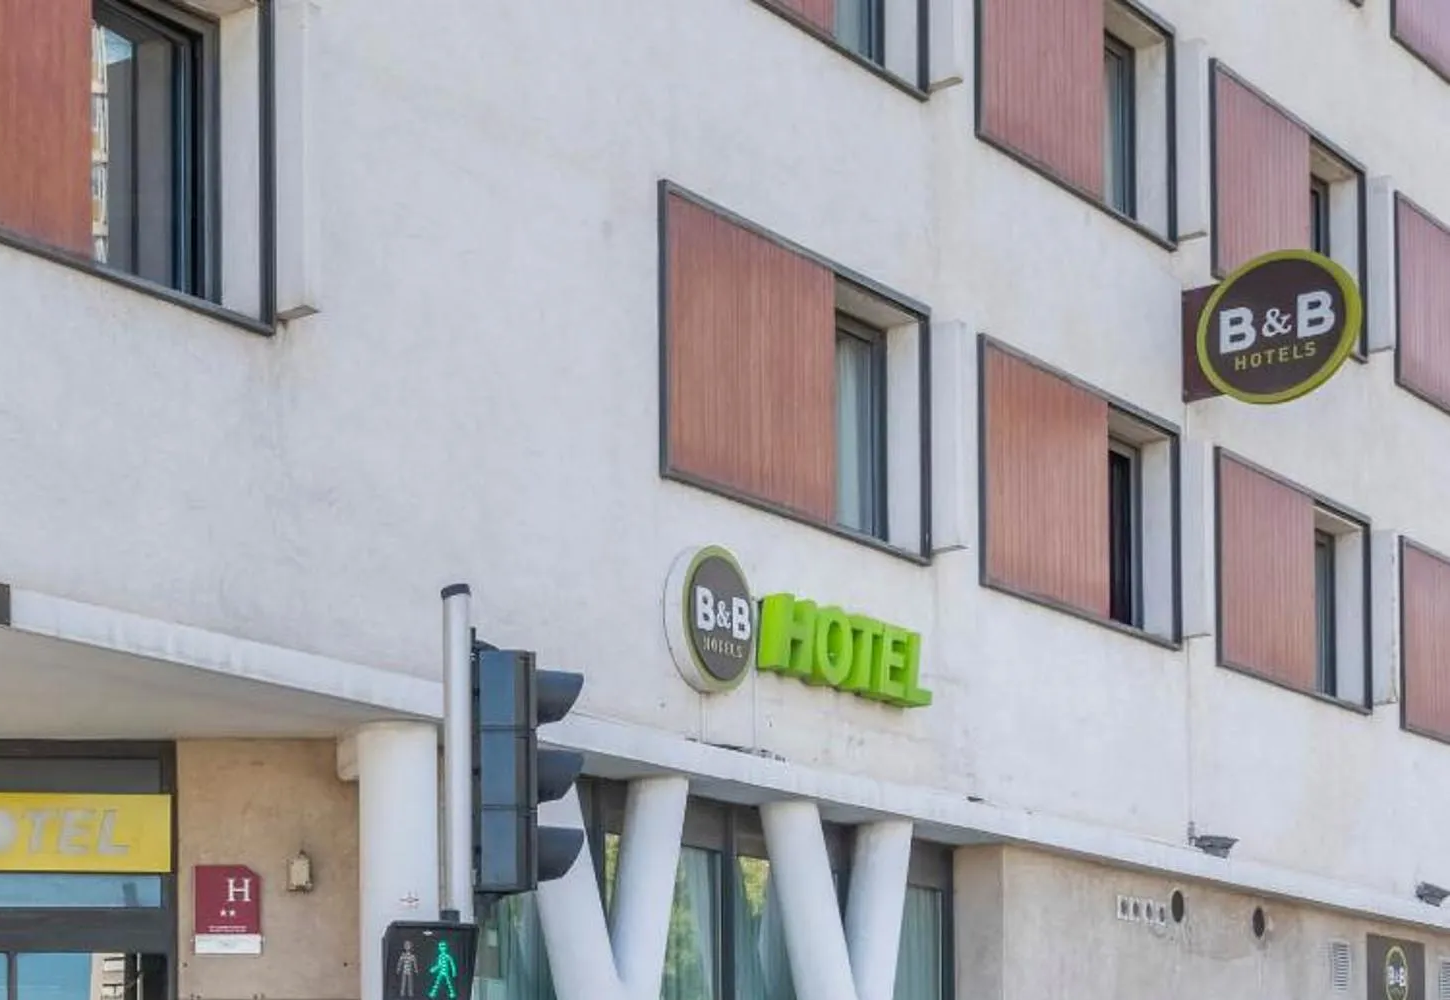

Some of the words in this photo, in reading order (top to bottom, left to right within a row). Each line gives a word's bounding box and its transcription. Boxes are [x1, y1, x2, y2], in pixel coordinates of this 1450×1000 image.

[1219, 290, 1336, 355] B&B
[1234, 341, 1317, 371] HOTELS
[695, 585, 751, 641] B&B
[702, 635, 744, 658] HOTELS
[757, 592, 933, 708] HOTEL
[227, 877, 252, 902] H
